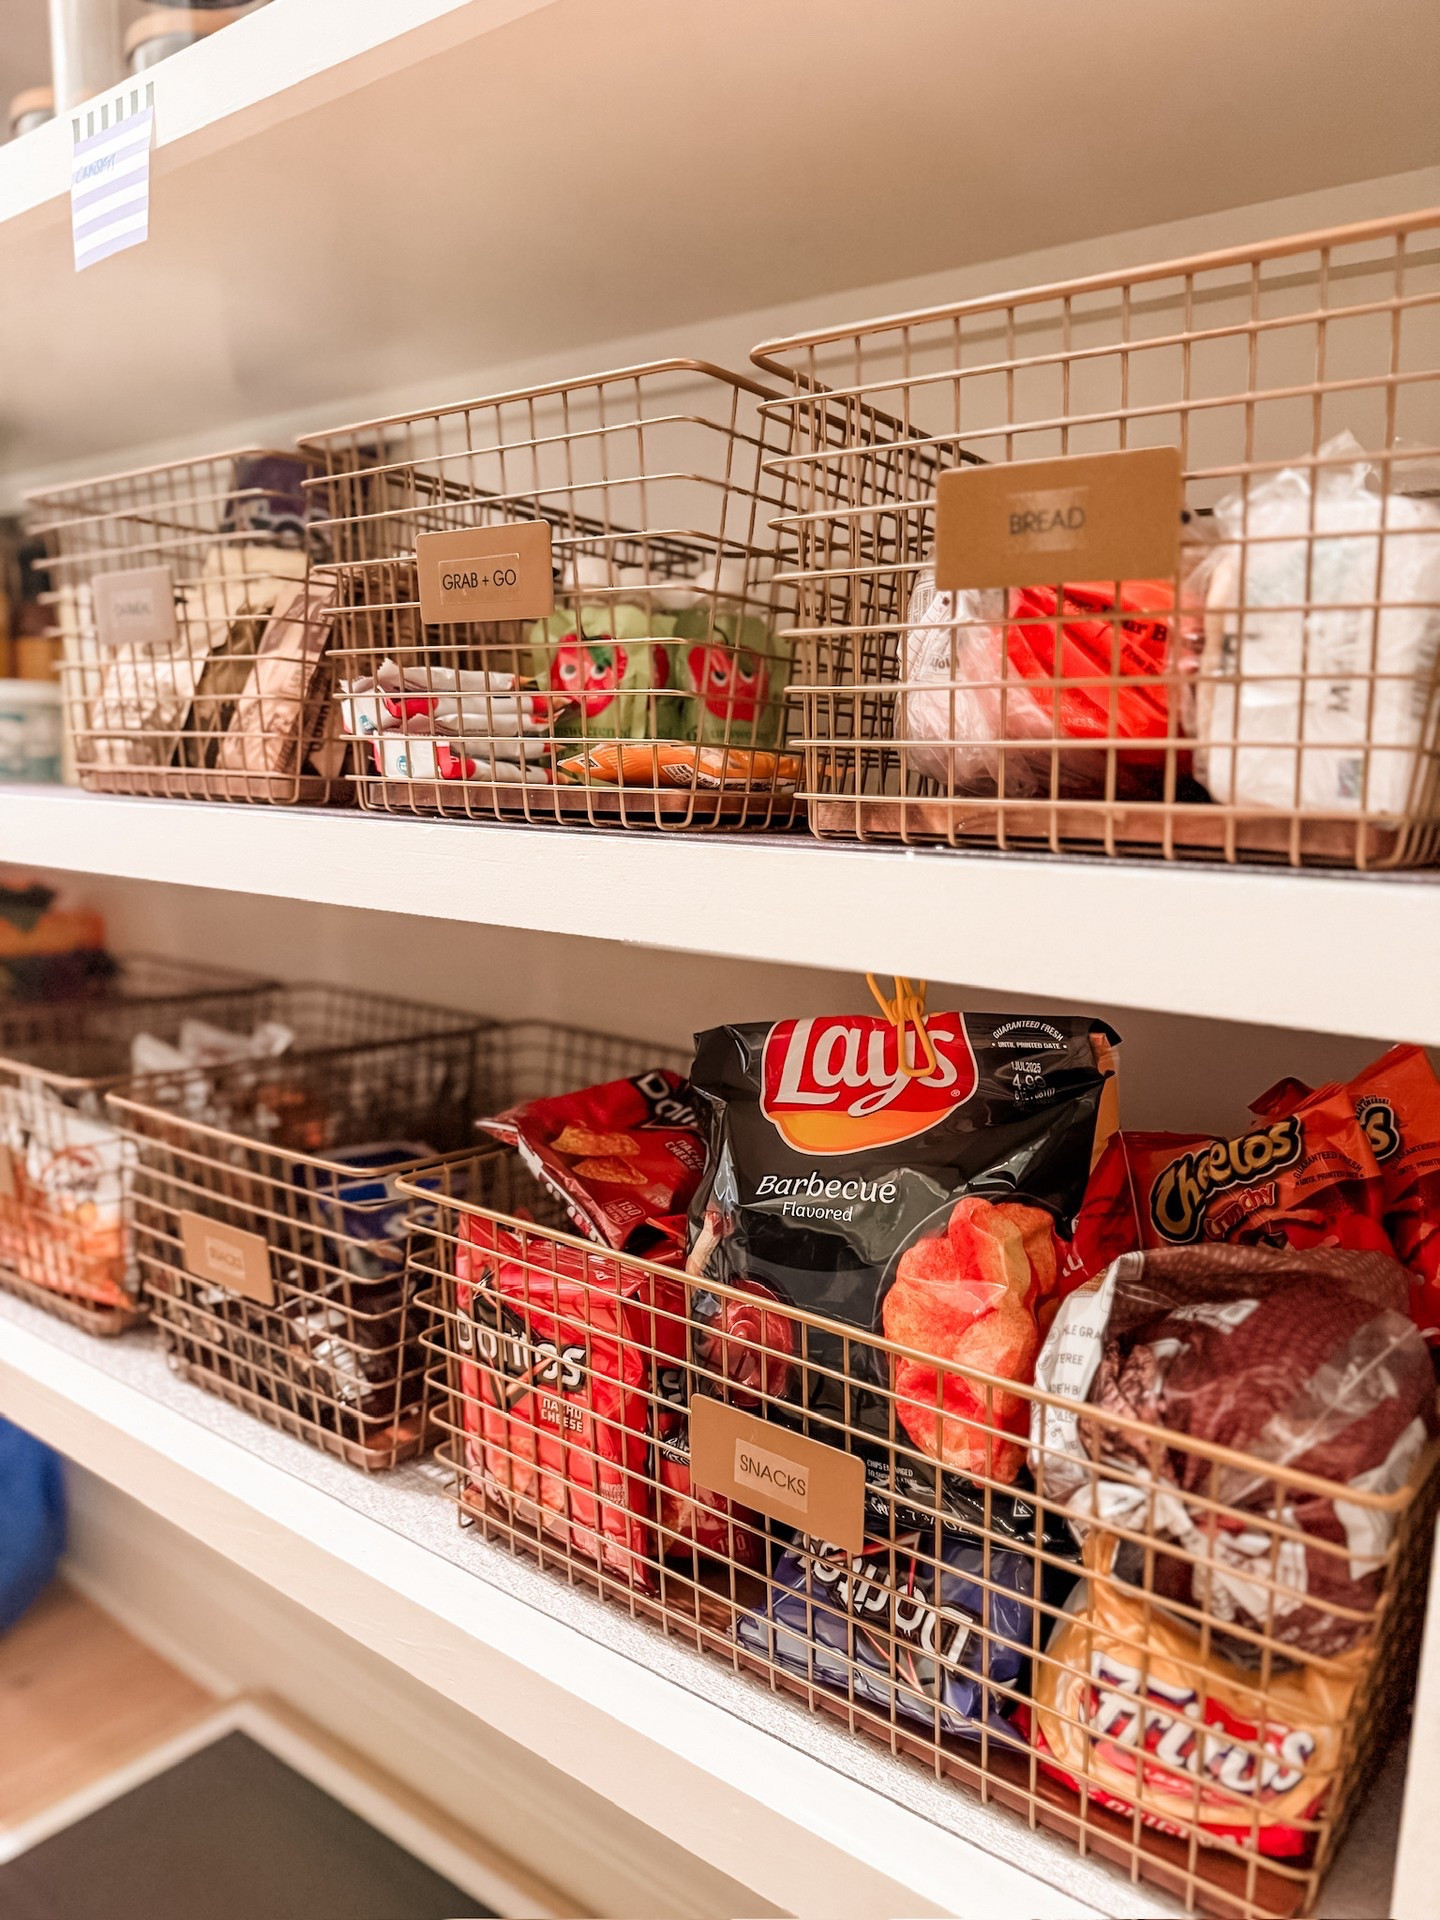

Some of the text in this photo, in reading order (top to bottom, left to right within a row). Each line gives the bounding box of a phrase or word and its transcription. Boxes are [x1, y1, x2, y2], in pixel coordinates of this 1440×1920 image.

[1009, 506, 1086, 535] BREAD
[442, 569, 517, 590] GRAB + GO
[992, 1020, 1064, 1041] GUARANTEED FRESH
[1010, 1060, 1042, 1074] 1JUL2025
[1012, 1073, 1047, 1091] 4.99
[664, 1140, 699, 1171] CHEESE
[755, 1172, 897, 1204] Barbecue
[1152, 1116, 1299, 1240] Cheetos
[618, 1201, 642, 1216] 150
[782, 1201, 854, 1222] Flavored
[1203, 1181, 1277, 1240] Crunchy
[543, 1398, 582, 1419] NAHO
[541, 1409, 583, 1432] CHEESE
[739, 1454, 806, 1496] SNACKS
[866, 1459, 883, 1470] CHIPS
[1089, 1650, 1315, 1792] Fritos
